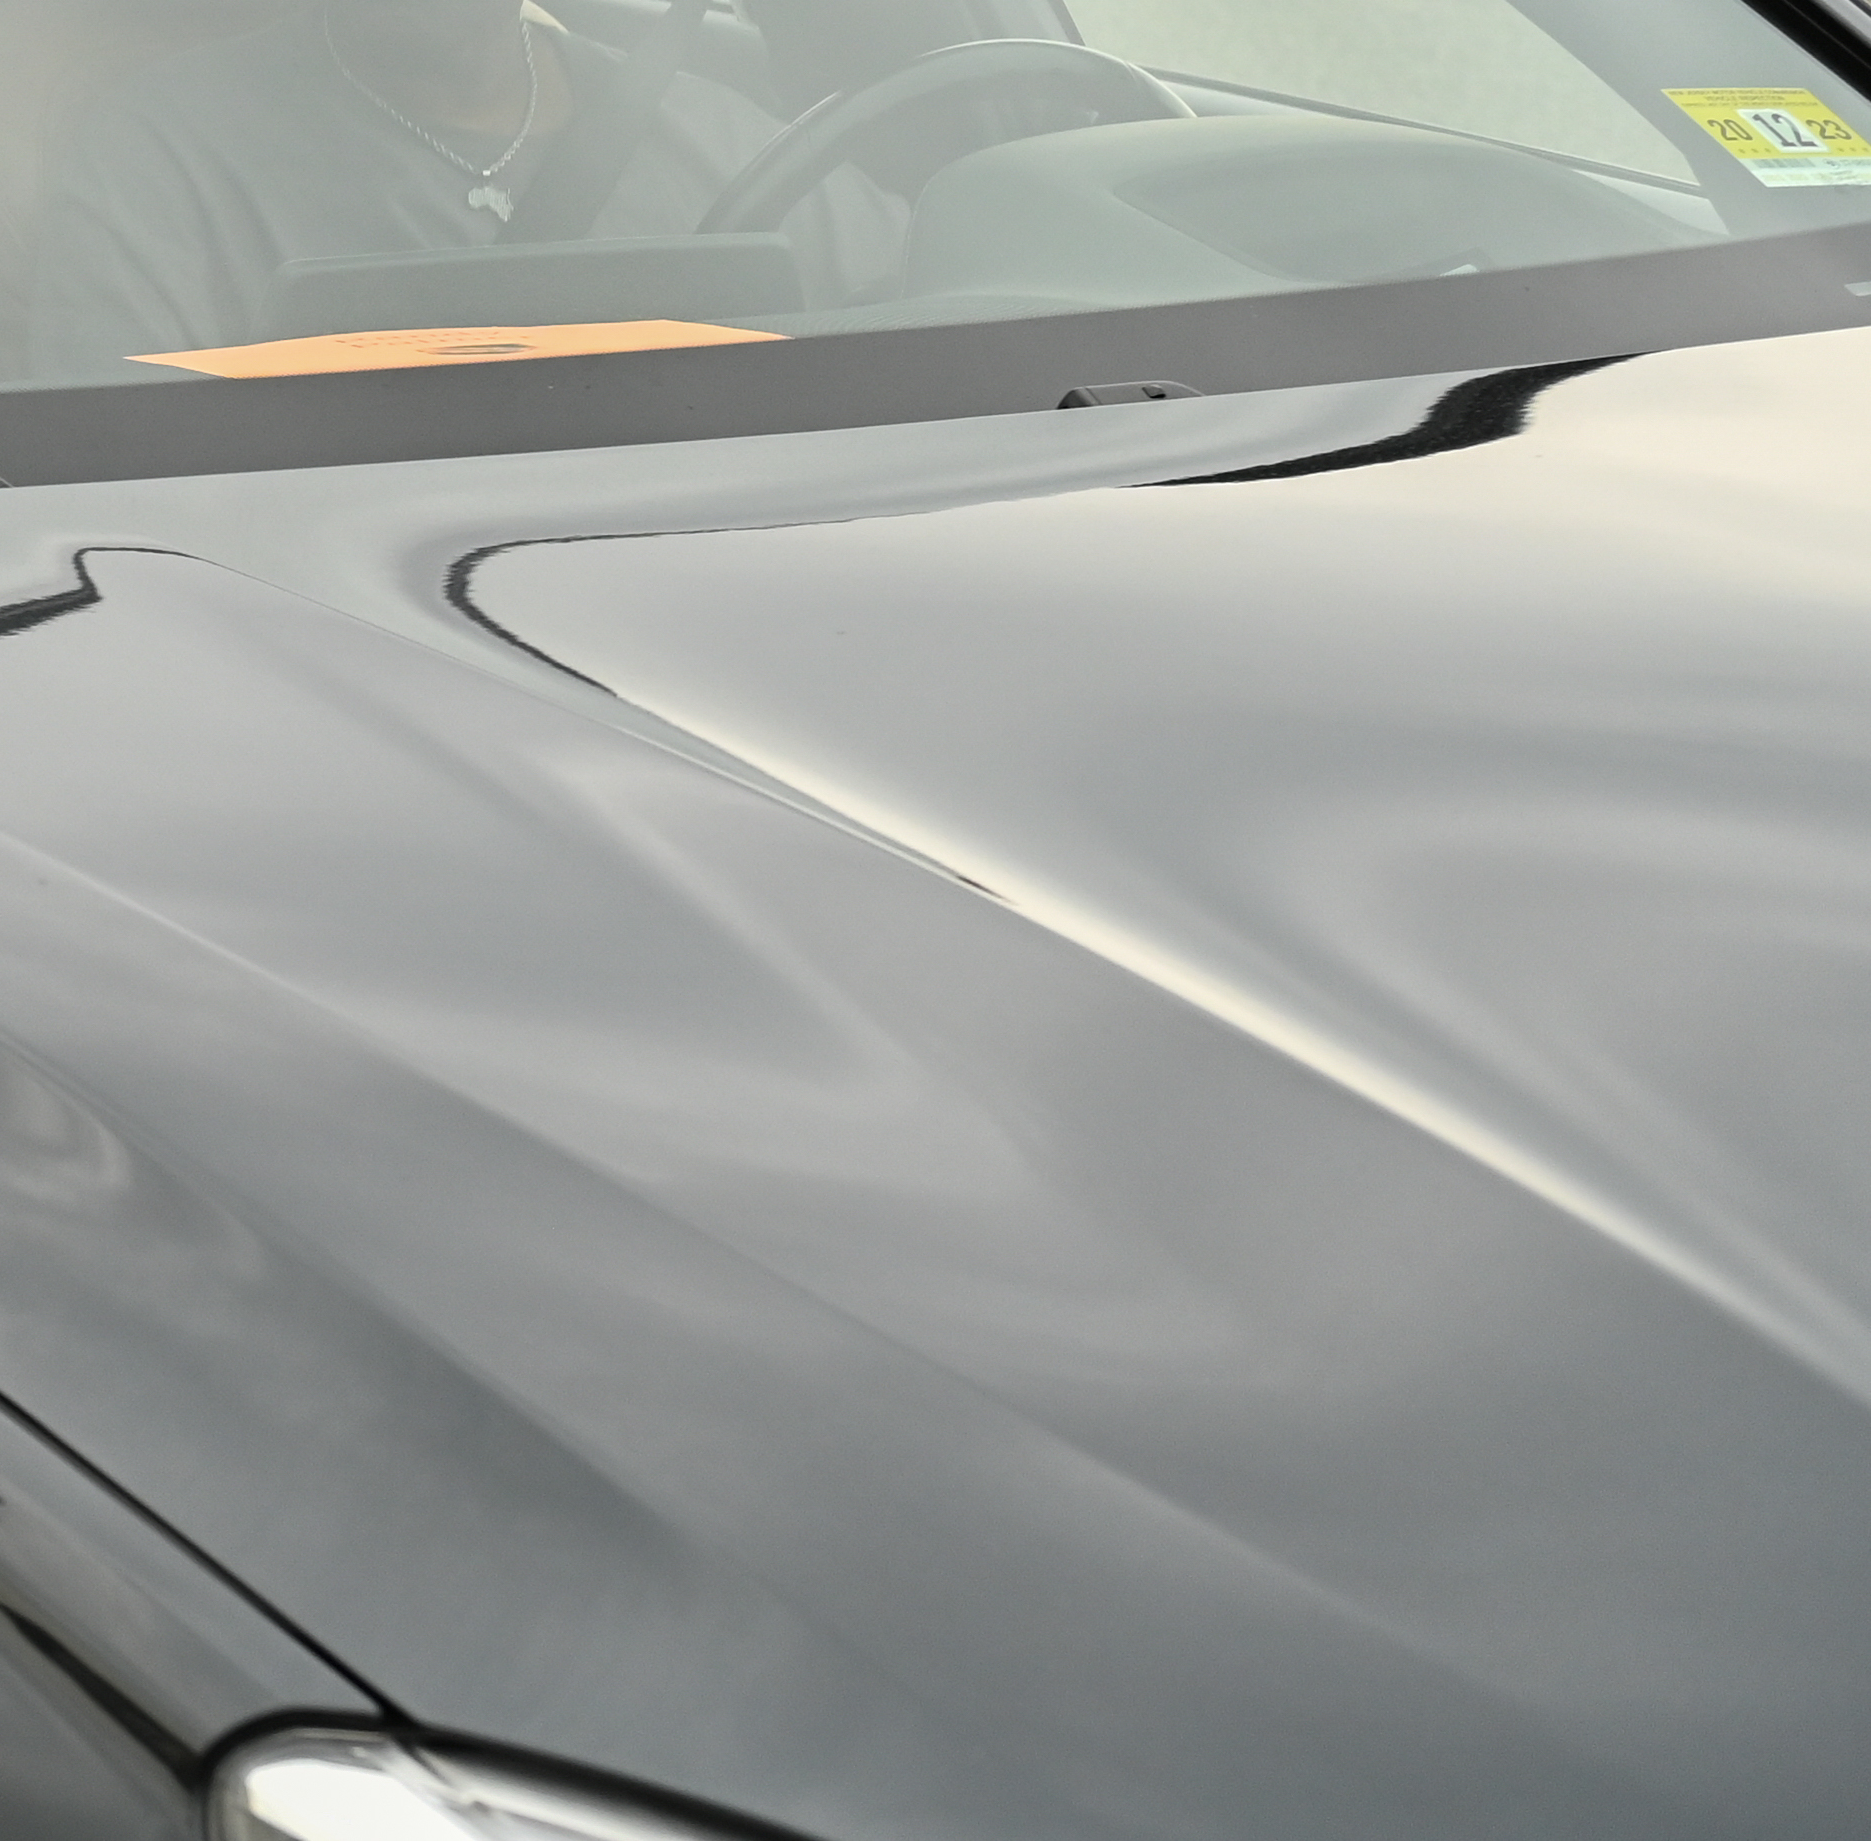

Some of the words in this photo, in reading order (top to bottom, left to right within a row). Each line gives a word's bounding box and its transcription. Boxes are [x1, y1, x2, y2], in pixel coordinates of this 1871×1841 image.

[1707, 119, 1753, 141] 20
[1752, 113, 1819, 147] 12
[1805, 119, 1853, 141] 23
